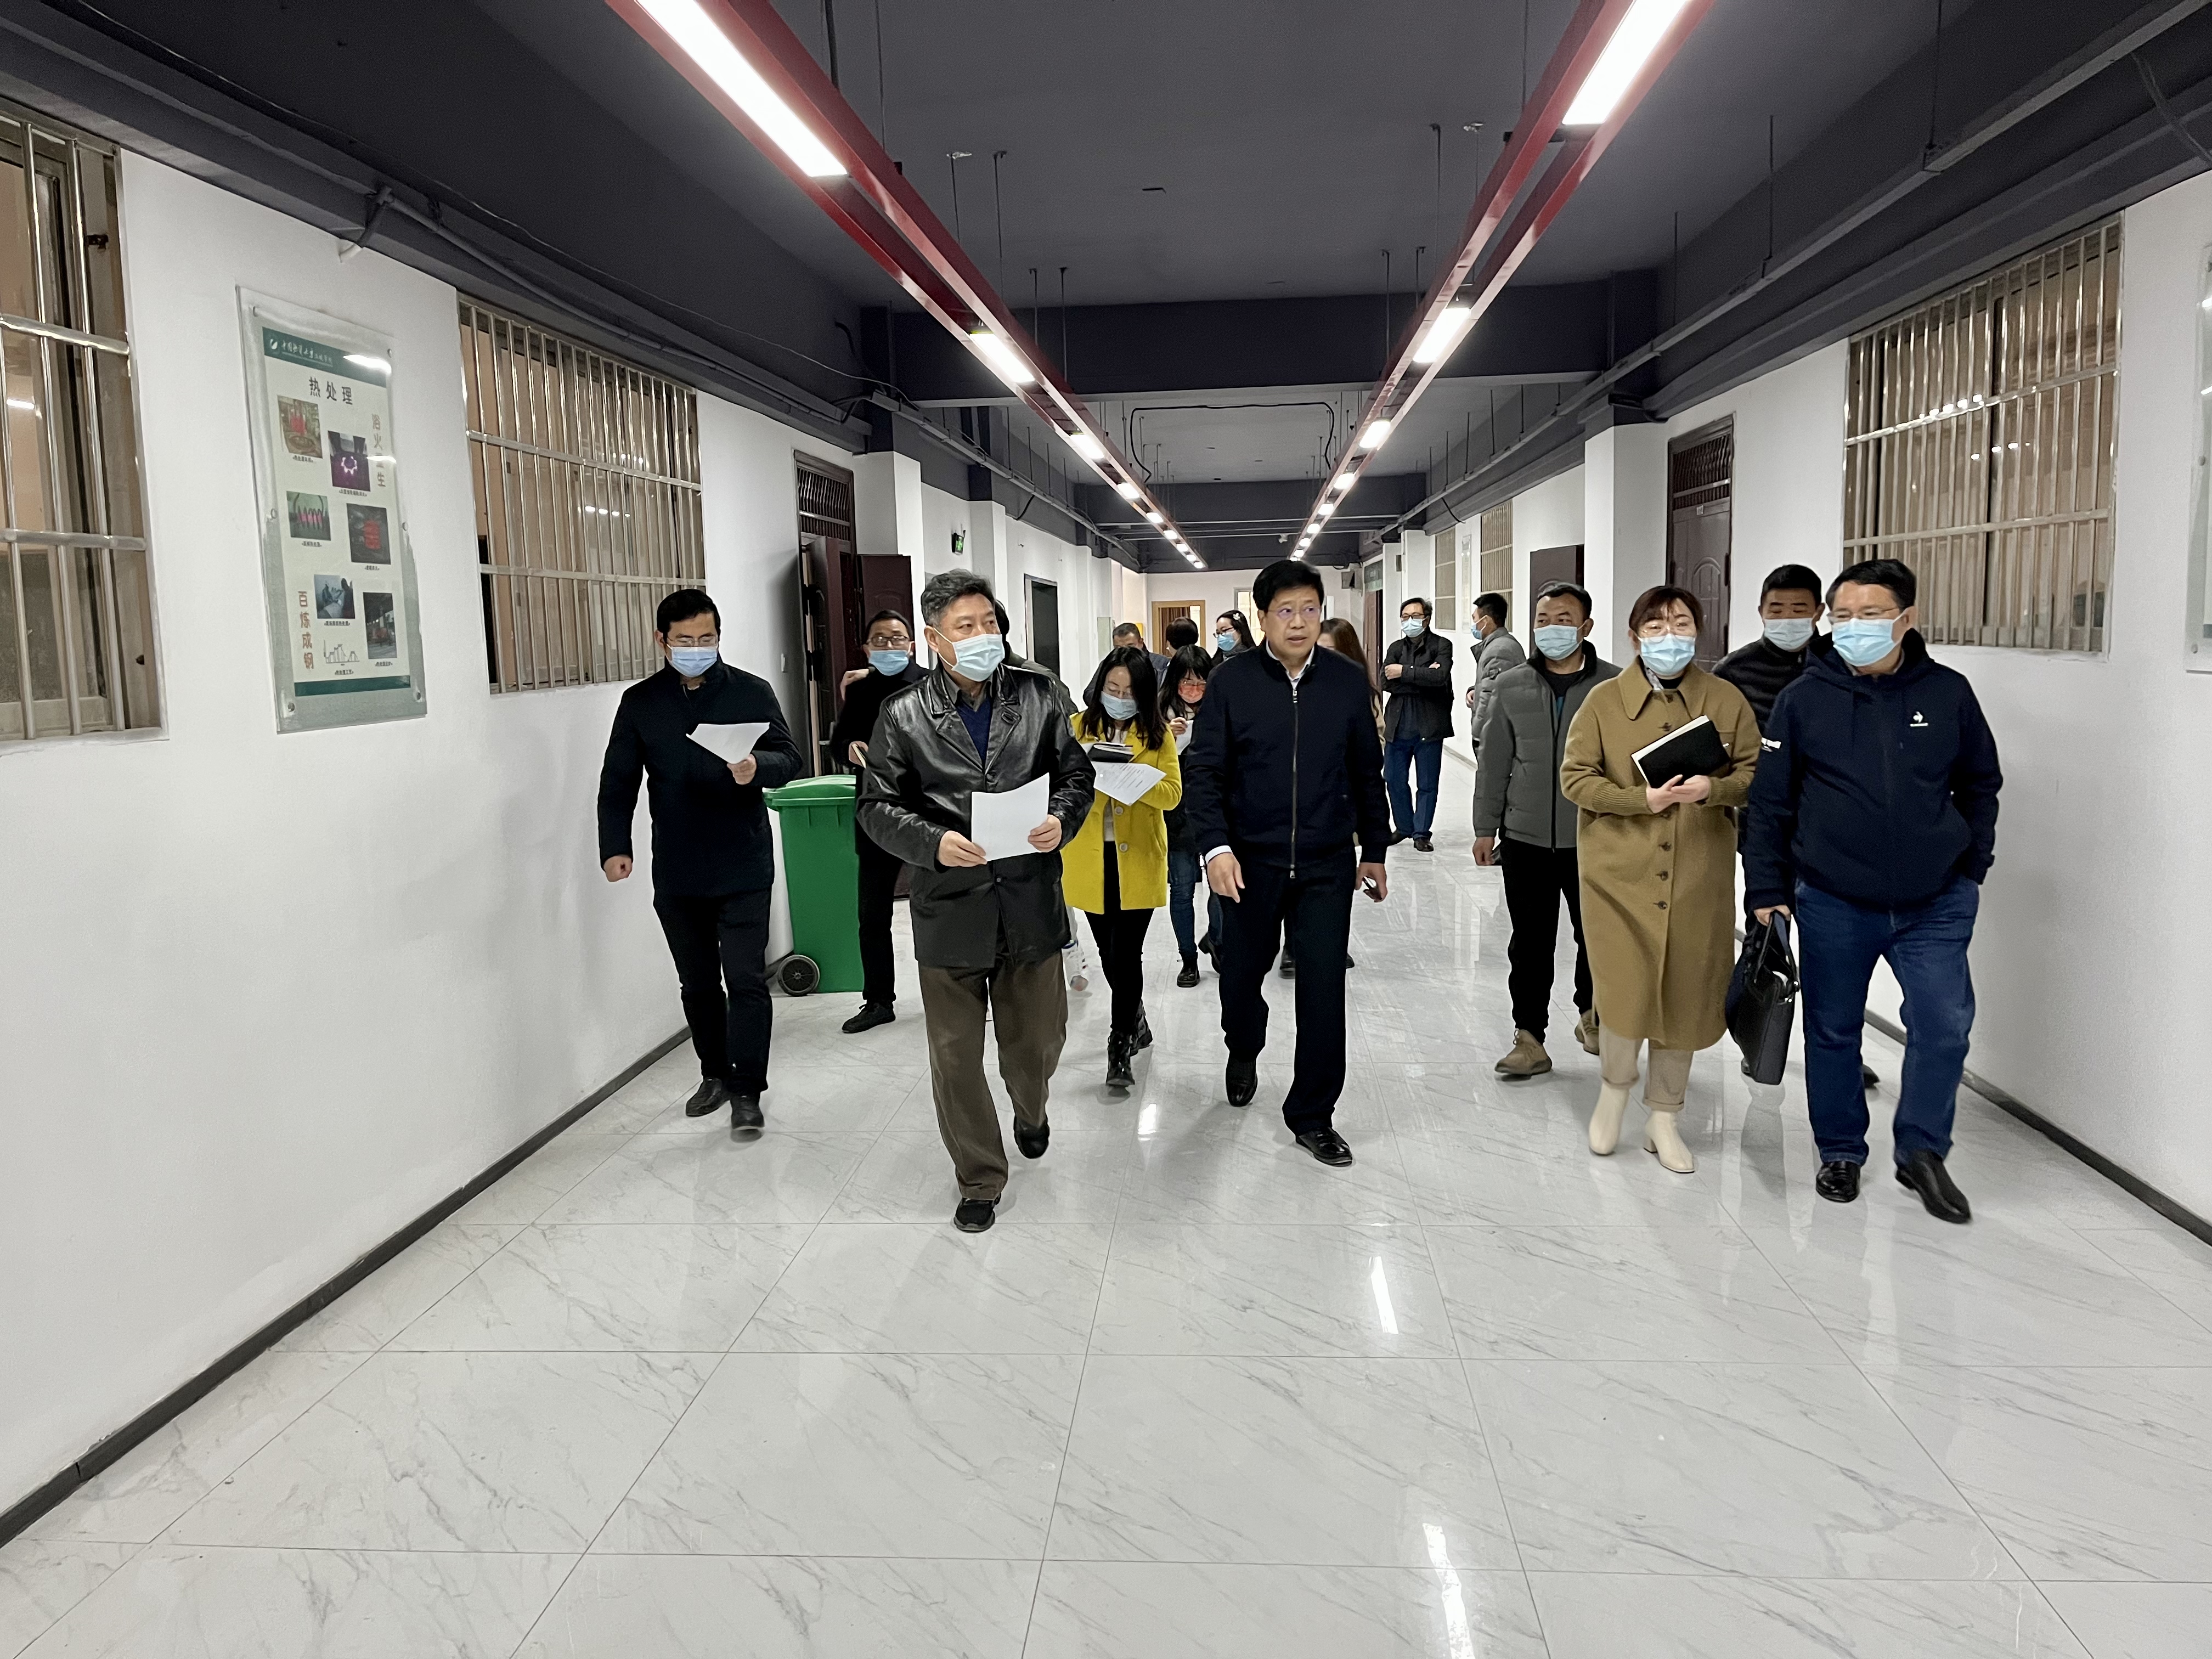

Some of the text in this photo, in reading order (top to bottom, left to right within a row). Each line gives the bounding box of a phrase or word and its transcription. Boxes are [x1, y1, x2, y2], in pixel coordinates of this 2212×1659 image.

[309, 376, 353, 405] 热处理
[298, 591, 314, 669] 百炼成钢
